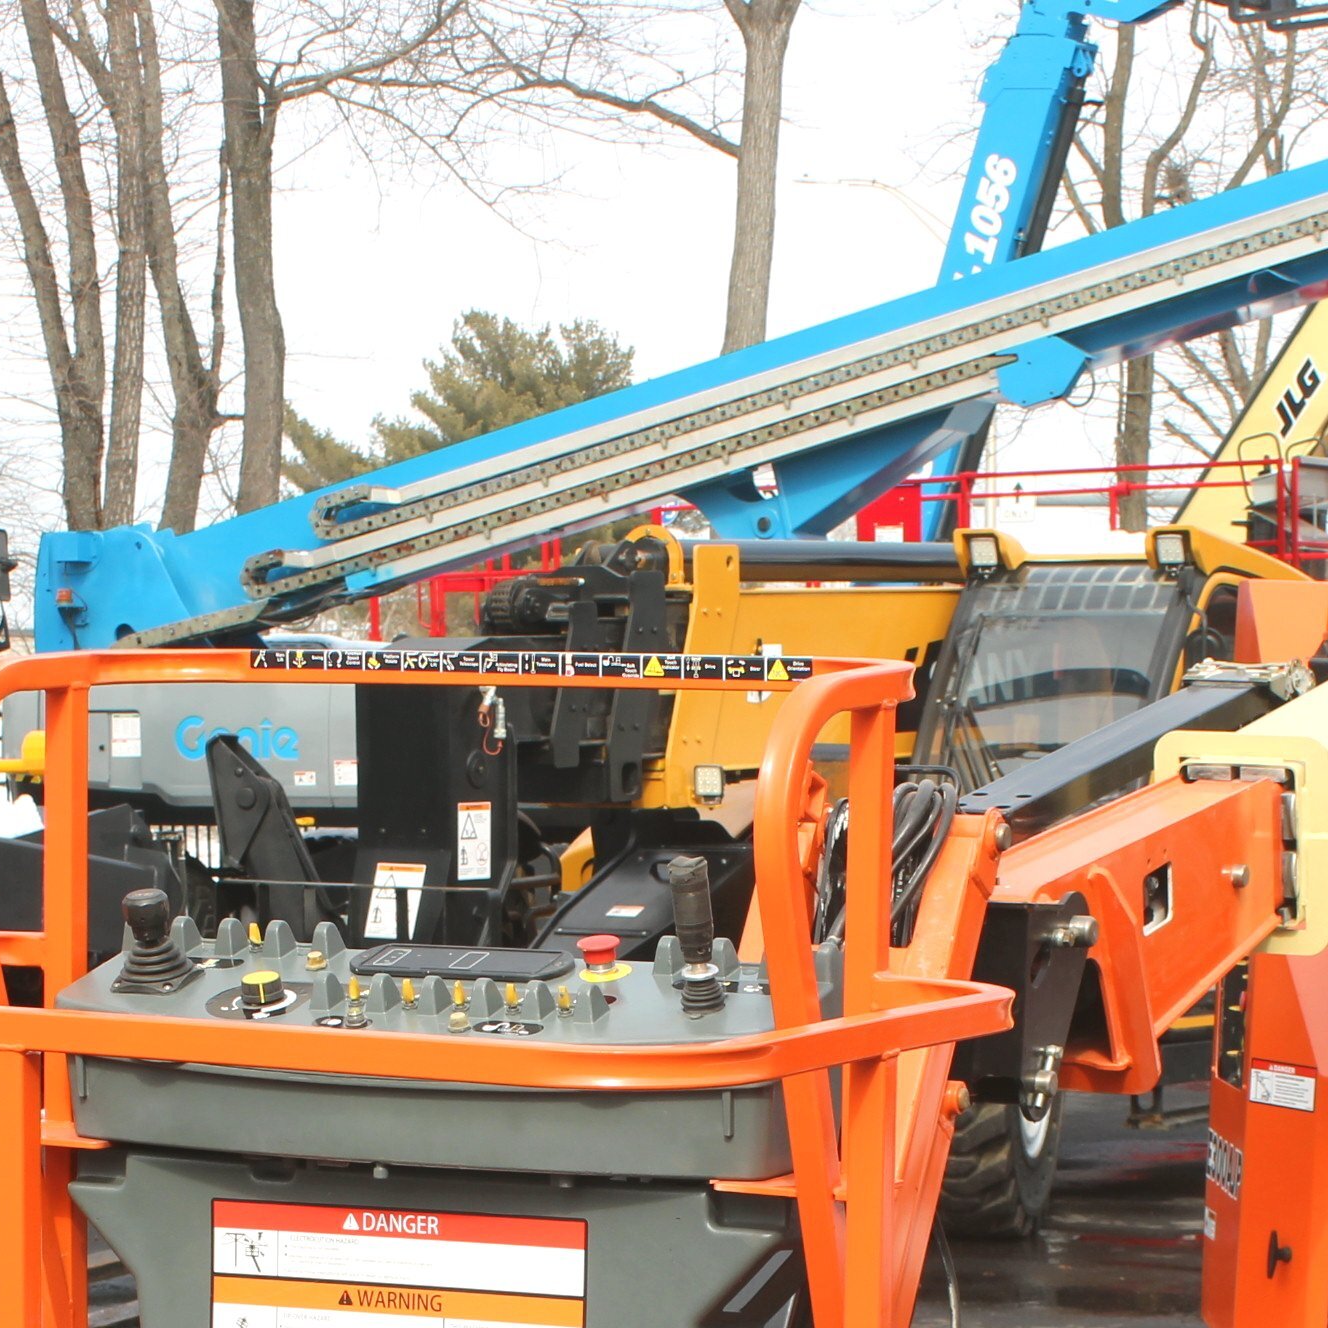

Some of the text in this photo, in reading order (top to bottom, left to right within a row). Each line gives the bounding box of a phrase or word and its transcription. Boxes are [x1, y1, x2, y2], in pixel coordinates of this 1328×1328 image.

[964, 153, 1017, 265] 1056
[1275, 357, 1321, 438] JLG
[1273, 1065, 1296, 1074] DANGER
[362, 1212, 439, 1235] DANGER
[357, 1289, 443, 1312] WARNING
